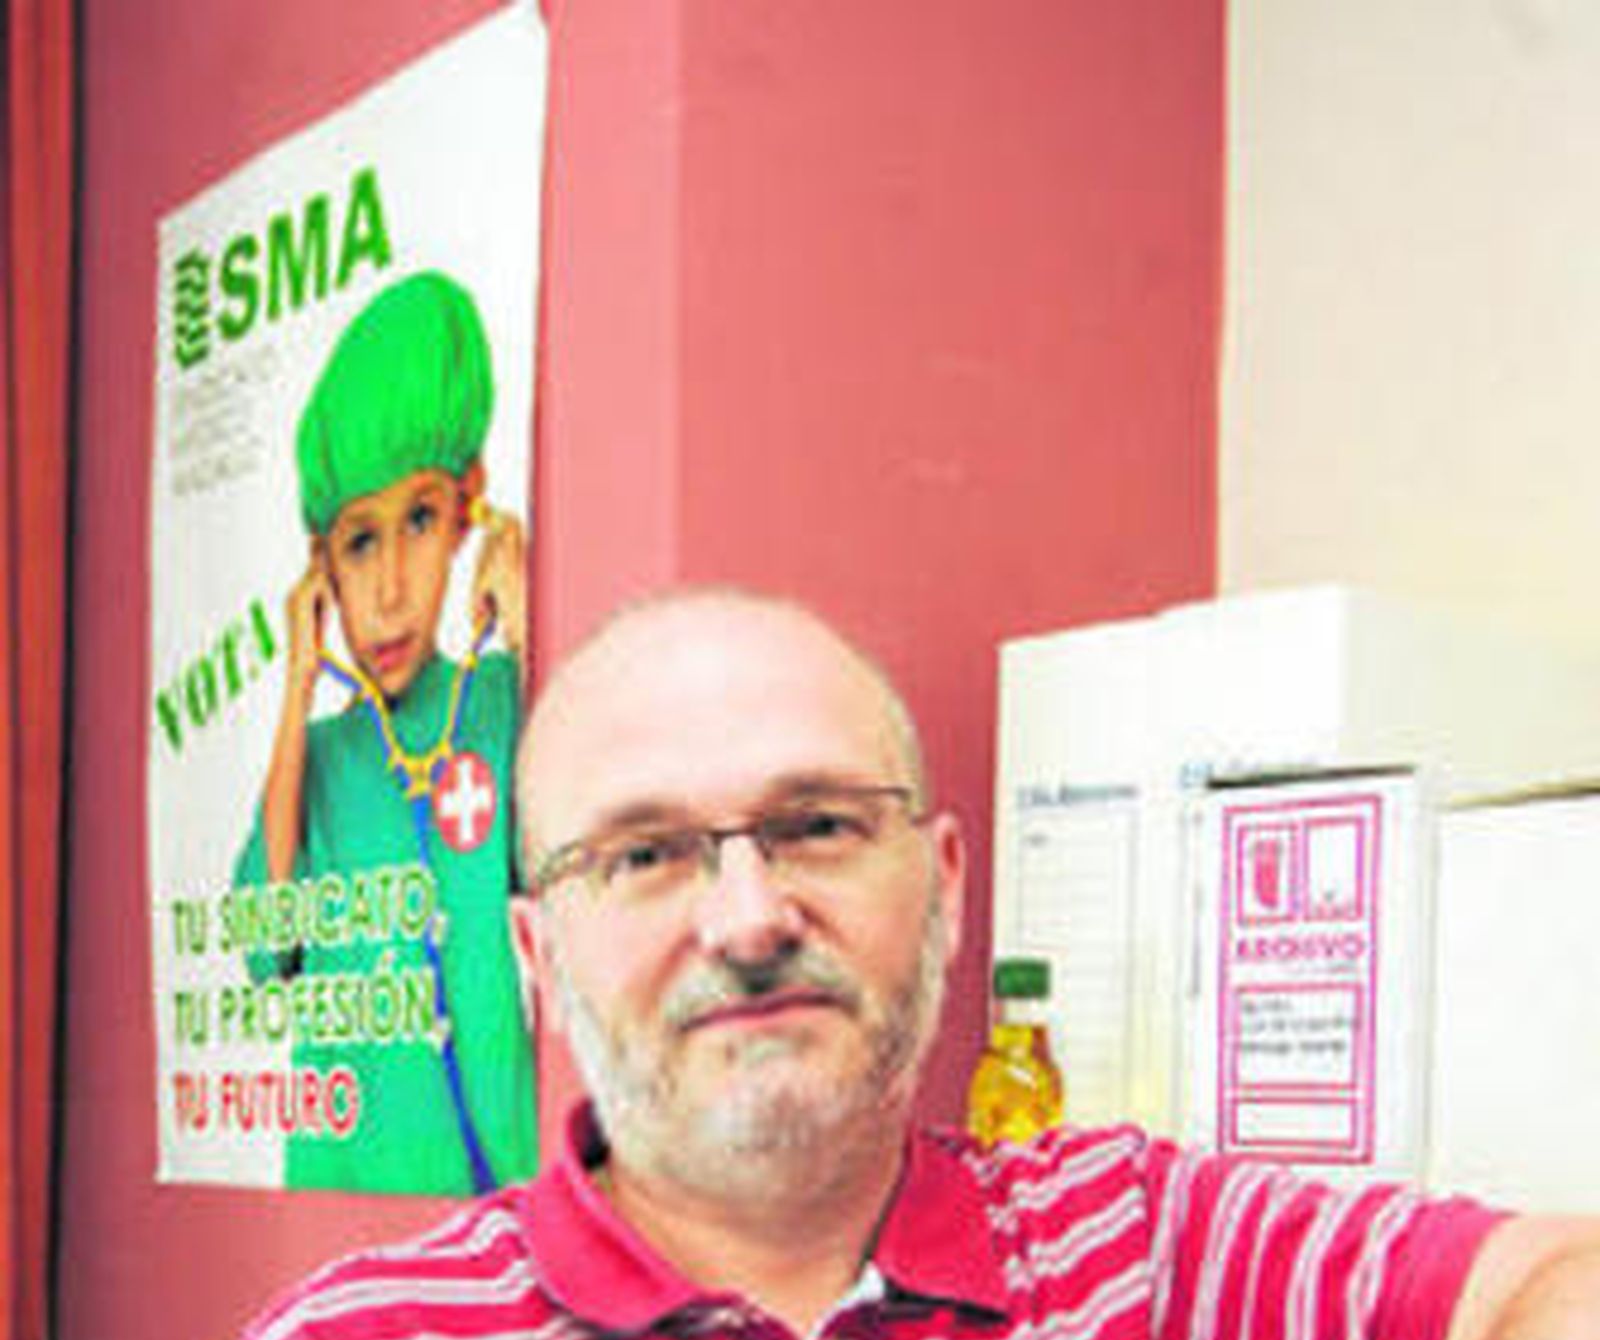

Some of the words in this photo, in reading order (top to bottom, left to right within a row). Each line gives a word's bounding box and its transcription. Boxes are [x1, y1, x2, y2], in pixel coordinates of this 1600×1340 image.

[174, 898, 208, 955] TU
[174, 992, 208, 1046] TU
[173, 1070, 209, 1132] TU
[219, 1067, 359, 1136] FUTURO
